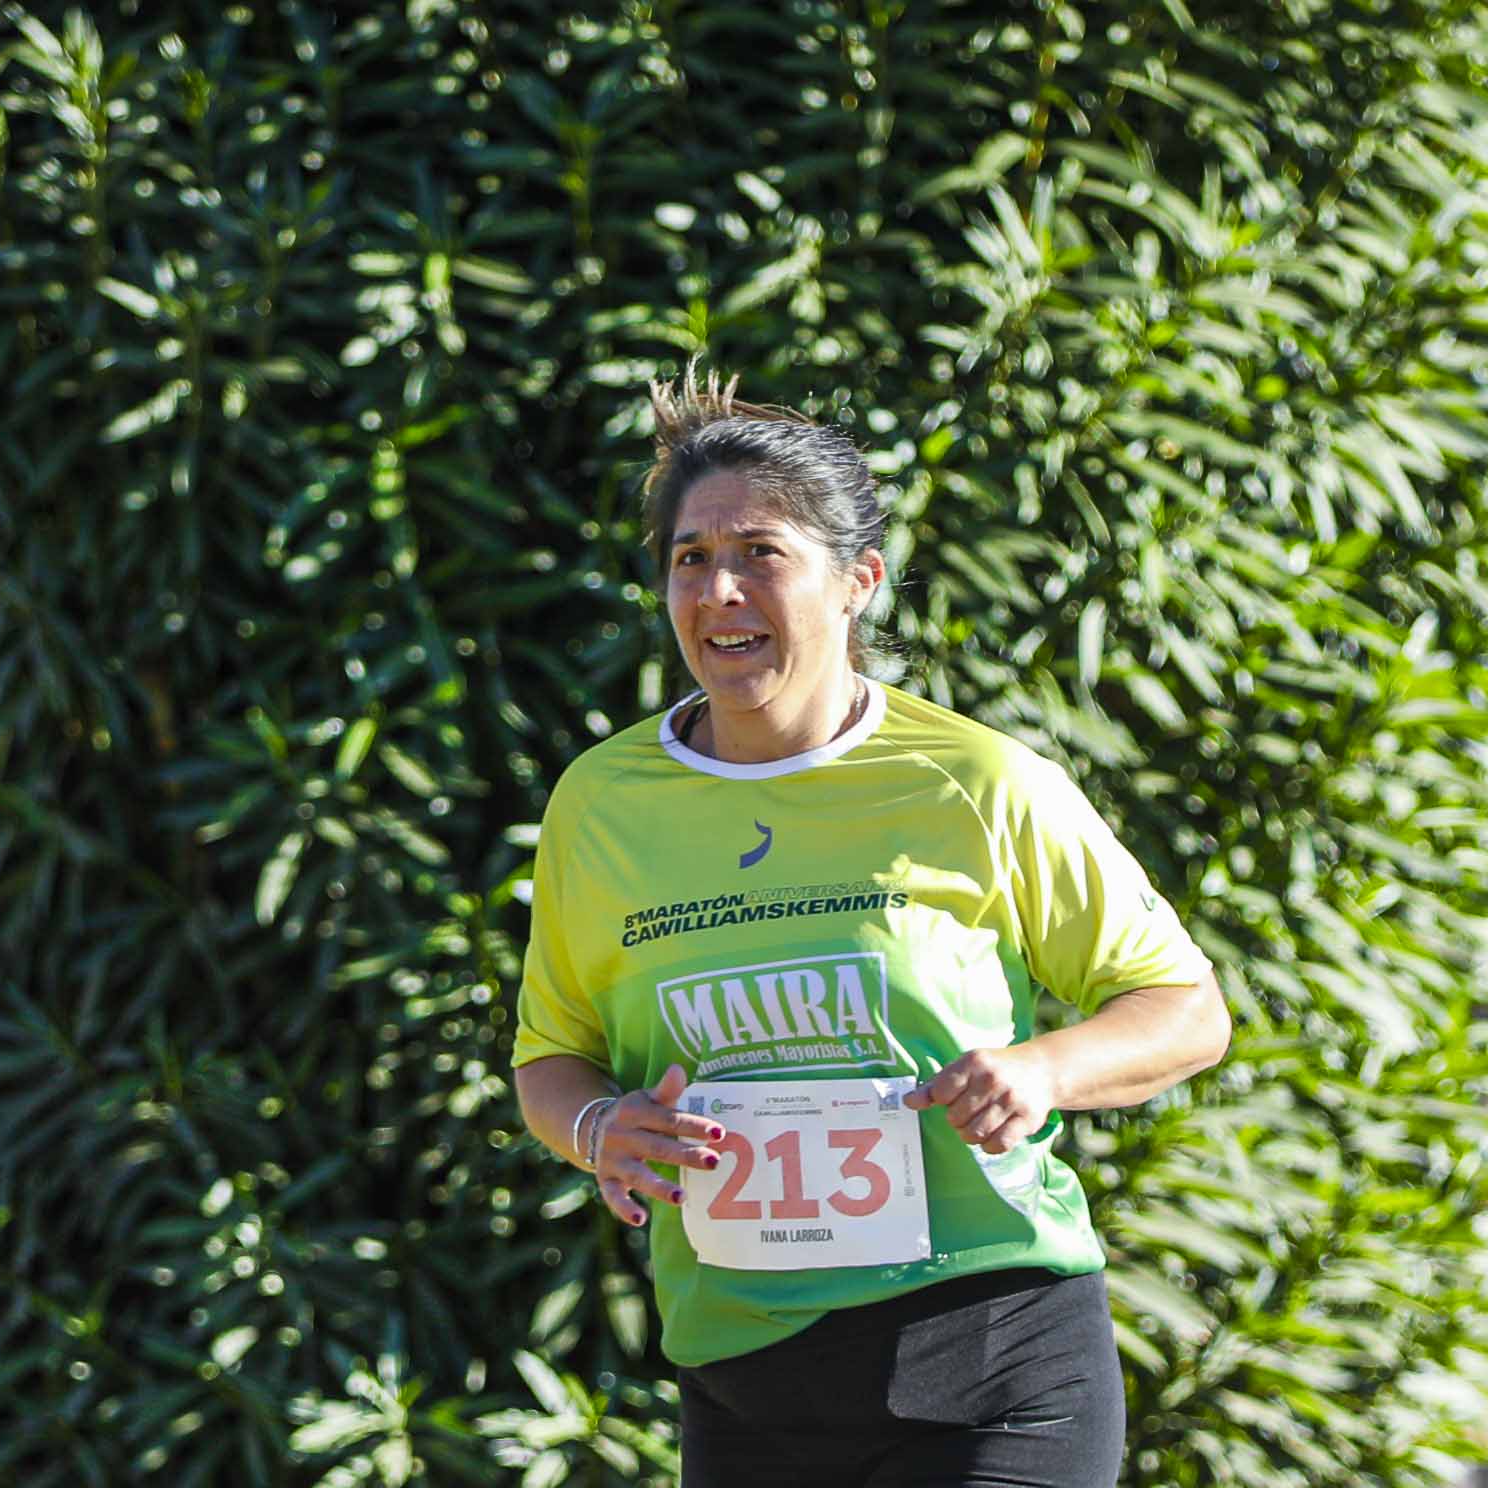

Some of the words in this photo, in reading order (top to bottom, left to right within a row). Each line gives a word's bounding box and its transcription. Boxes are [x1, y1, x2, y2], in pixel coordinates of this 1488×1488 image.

[668, 964, 877, 1052] MAIRA
[775, 1042, 851, 1063] Mayoristas
[707, 1128, 891, 1220] 213
[760, 1229, 789, 1243] IVANA
